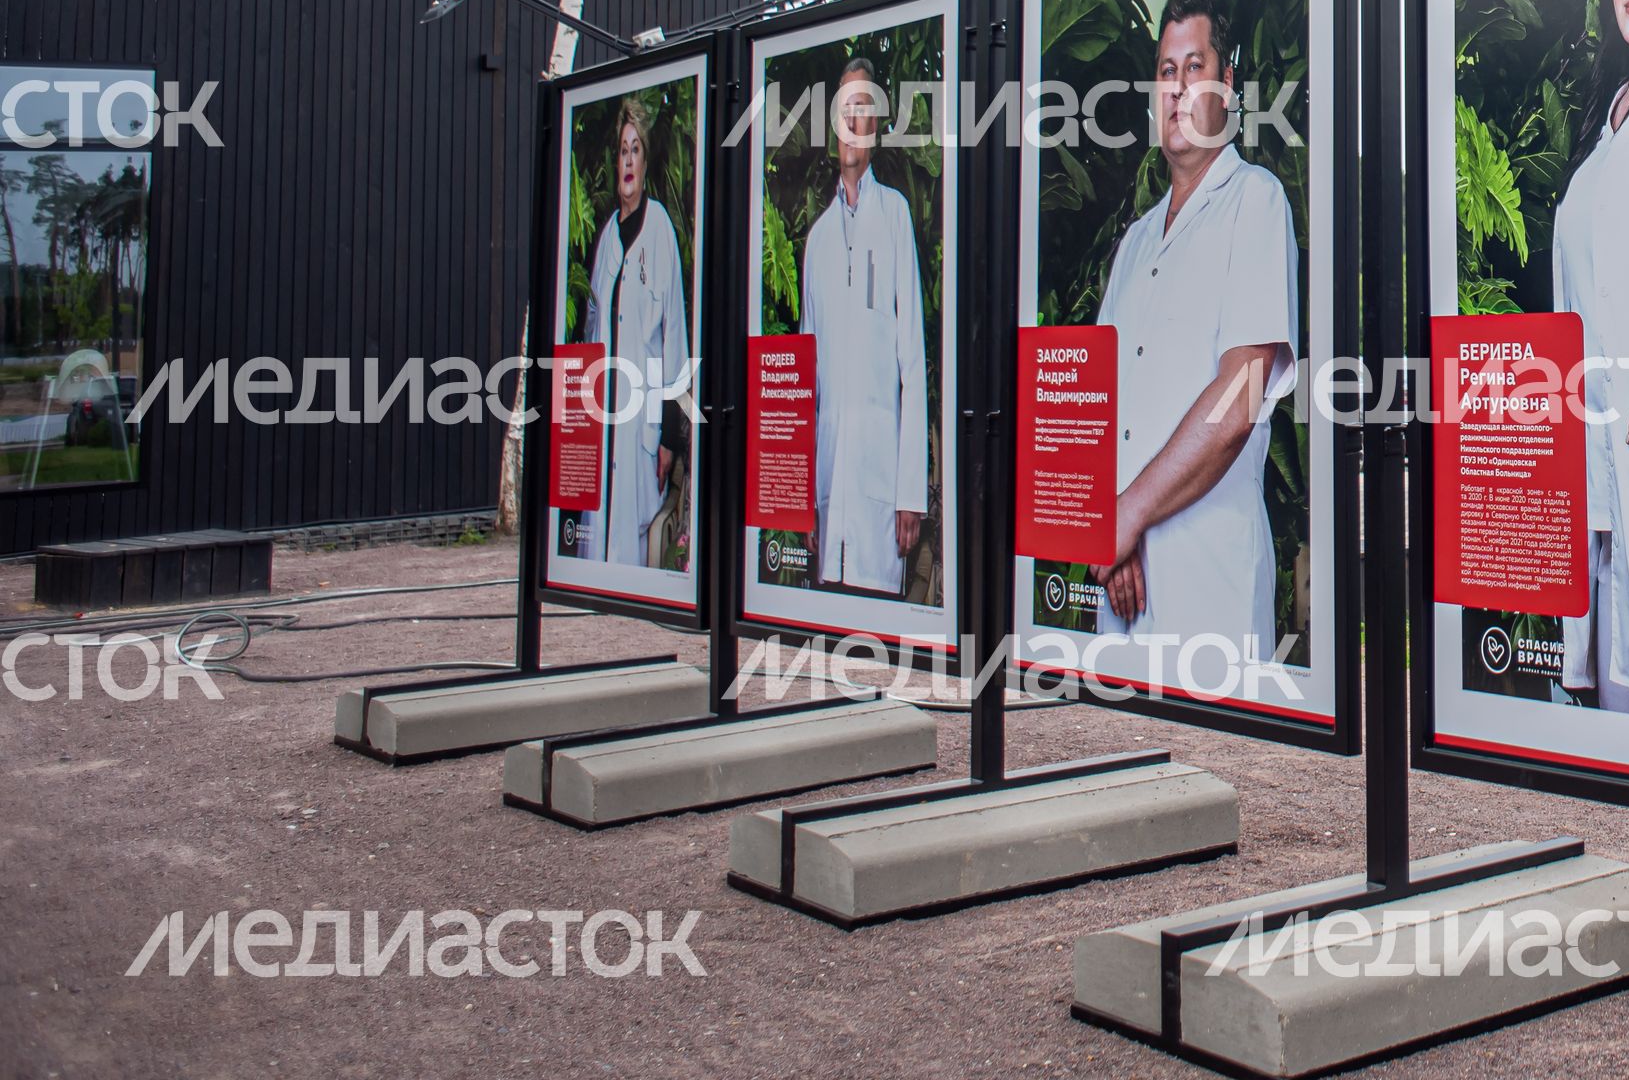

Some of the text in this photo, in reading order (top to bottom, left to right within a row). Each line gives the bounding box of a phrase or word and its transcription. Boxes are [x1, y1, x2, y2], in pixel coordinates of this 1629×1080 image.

[1037, 349, 1088, 363] ЗАКОРКО
[1460, 343, 1535, 361] БЕРИЕВА
[761, 353, 795, 366] ГОРДЕЕВ
[761, 370, 799, 384] Владимир
[1037, 369, 1078, 385] Андрей
[1460, 368, 1515, 385] Регина
[1036, 388, 1107, 406] Владимирович
[1461, 392, 1549, 414] Артуровна
[1460, 422, 1500, 431] Заведующая
[1519, 436, 1553, 444] отделения
[1461, 445, 1500, 453] Никольского
[1461, 456, 1476, 464] ГБУЗ
[1478, 457, 1487, 465] МО
[1461, 467, 1494, 476] Областная
[1069, 583, 1105, 595] СПАСИБО
[1069, 593, 1105, 606] ВРАЧАМ
